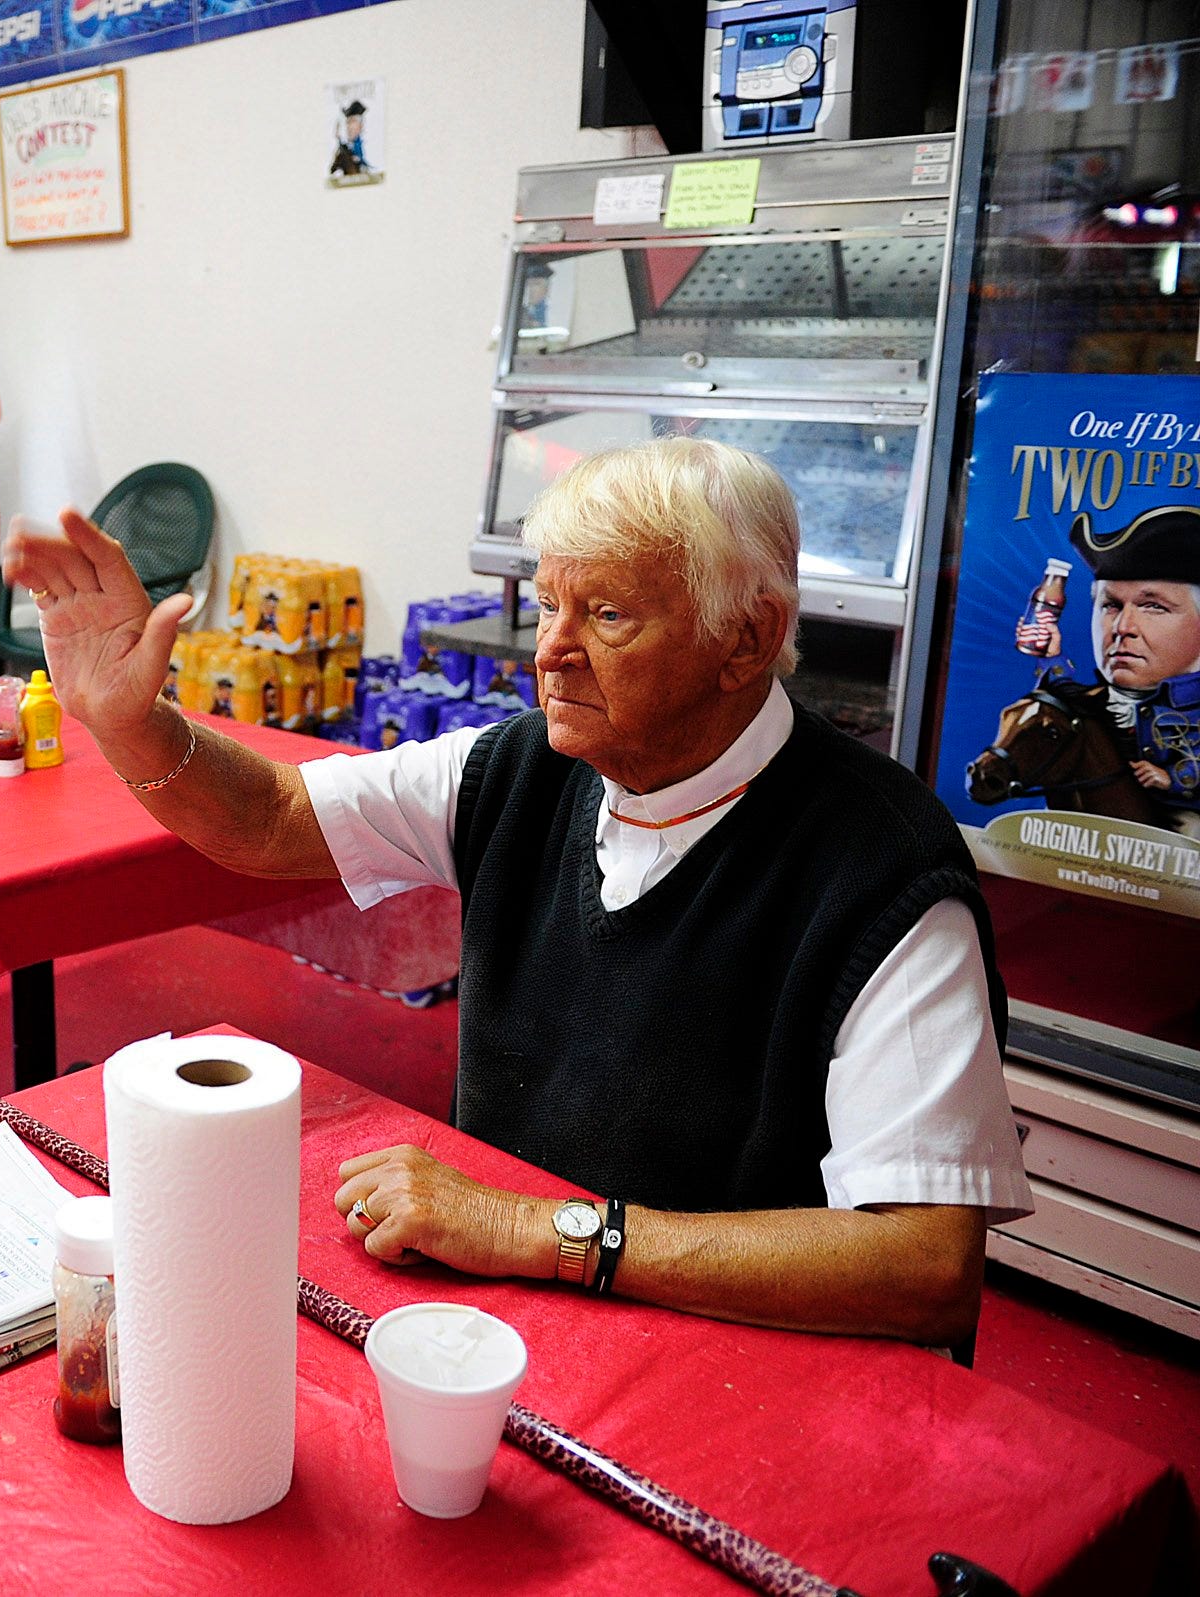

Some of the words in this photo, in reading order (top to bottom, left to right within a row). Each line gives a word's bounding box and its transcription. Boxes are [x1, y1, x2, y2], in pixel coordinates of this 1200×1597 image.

[16, 120, 97, 163] CONTEST
[1069, 411, 1124, 439] One
[1124, 412, 1157, 448] If
[1150, 413, 1193, 449] By
[1011, 445, 1124, 522] TWO
[1128, 451, 1168, 486] IF
[1020, 816, 1101, 859] ORIGINAL
[1104, 833, 1171, 873] SWEET
[1171, 846, 1200, 881] TE
